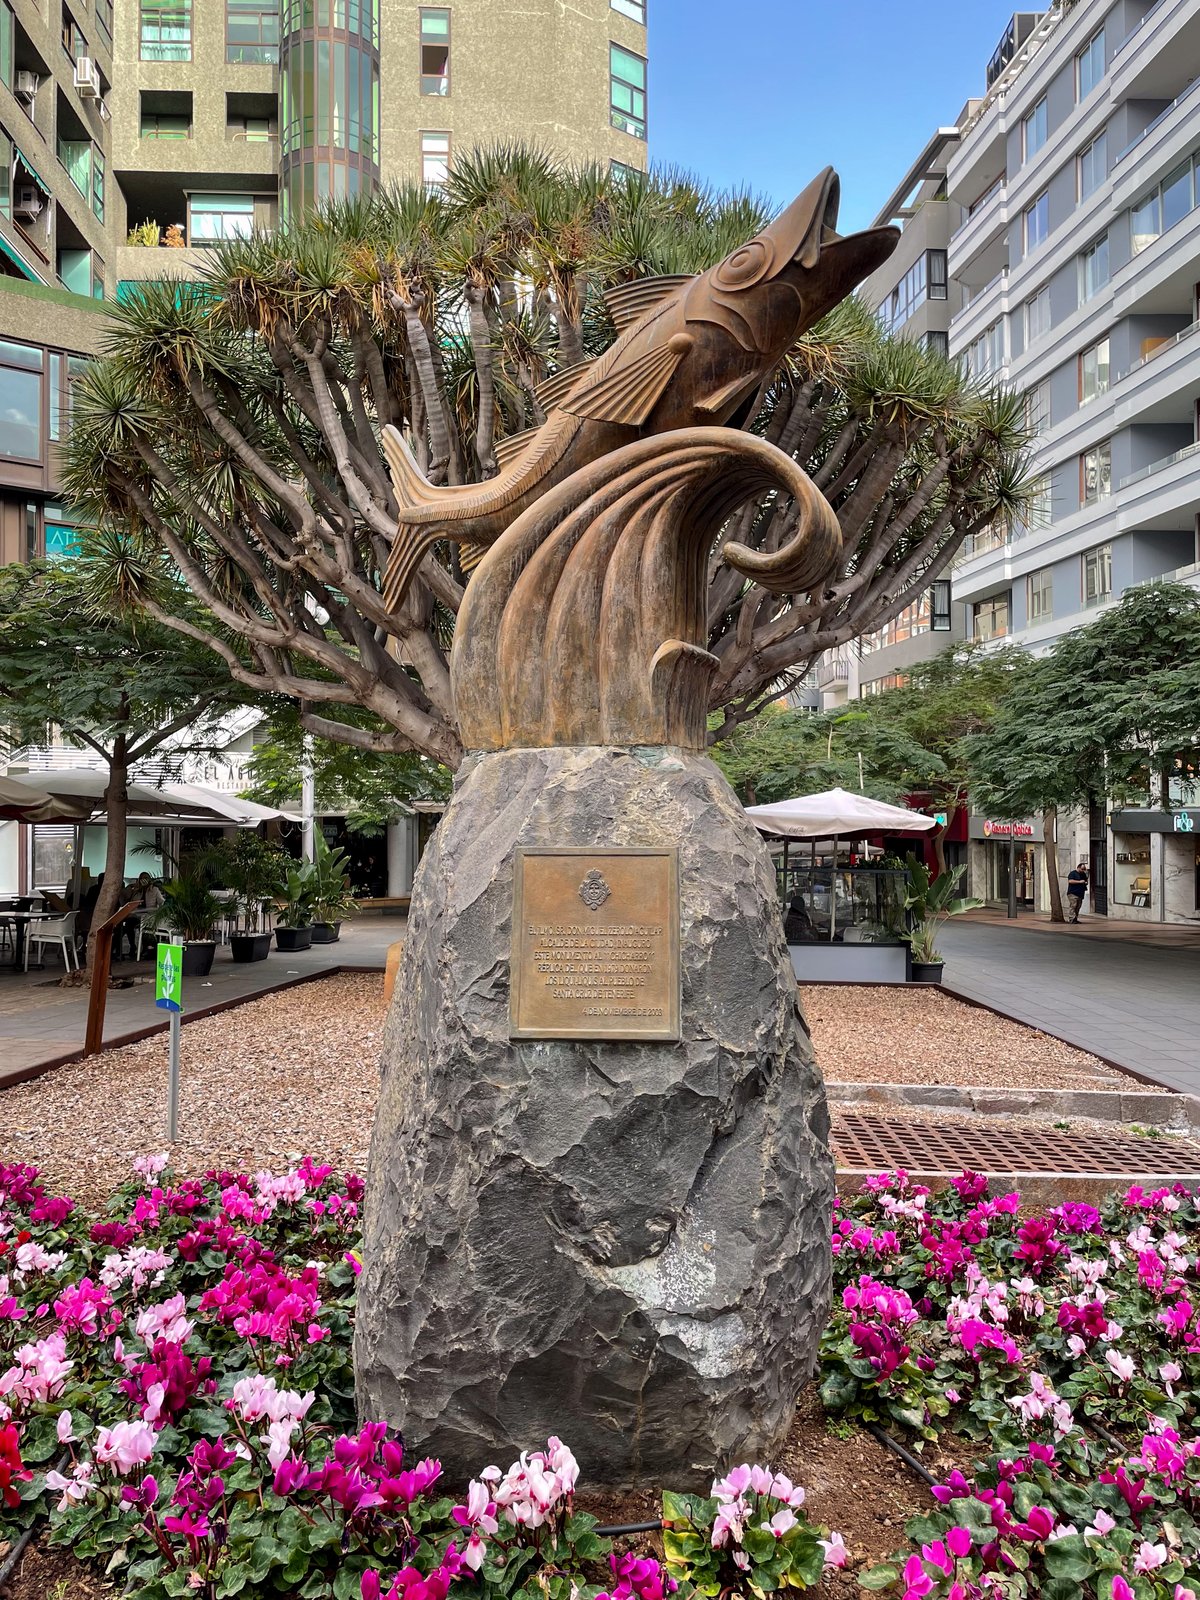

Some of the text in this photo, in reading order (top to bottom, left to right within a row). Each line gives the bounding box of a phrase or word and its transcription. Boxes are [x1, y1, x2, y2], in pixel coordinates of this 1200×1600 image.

[204, 766, 219, 780] EL
[991, 823, 1011, 834] Genera
[568, 925, 582, 936] DON
[582, 925, 608, 936] MIGUEL
[540, 938, 569, 949] ALCALDE
[570, 938, 579, 949] DE
[580, 938, 590, 949] LA
[534, 950, 550, 961] ESTE
[551, 950, 593, 961] MONUMENTO
[593, 950, 603, 961] AL
[565, 962, 578, 973] DEL
[578, 962, 593, 974] QUE
[619, 962, 653, 974] DONARON
[545, 975, 558, 986] LOS
[599, 975, 609, 986] AL
[609, 975, 634, 987] PUEBLO
[635, 976, 645, 987] DE
[552, 988, 636, 1000] SANTA CRUZ DE TENERIFE
[588, 1007, 598, 1016] DE
[598, 1007, 637, 1017] NOVIEMBRE
[637, 1008, 647, 1017] DE
